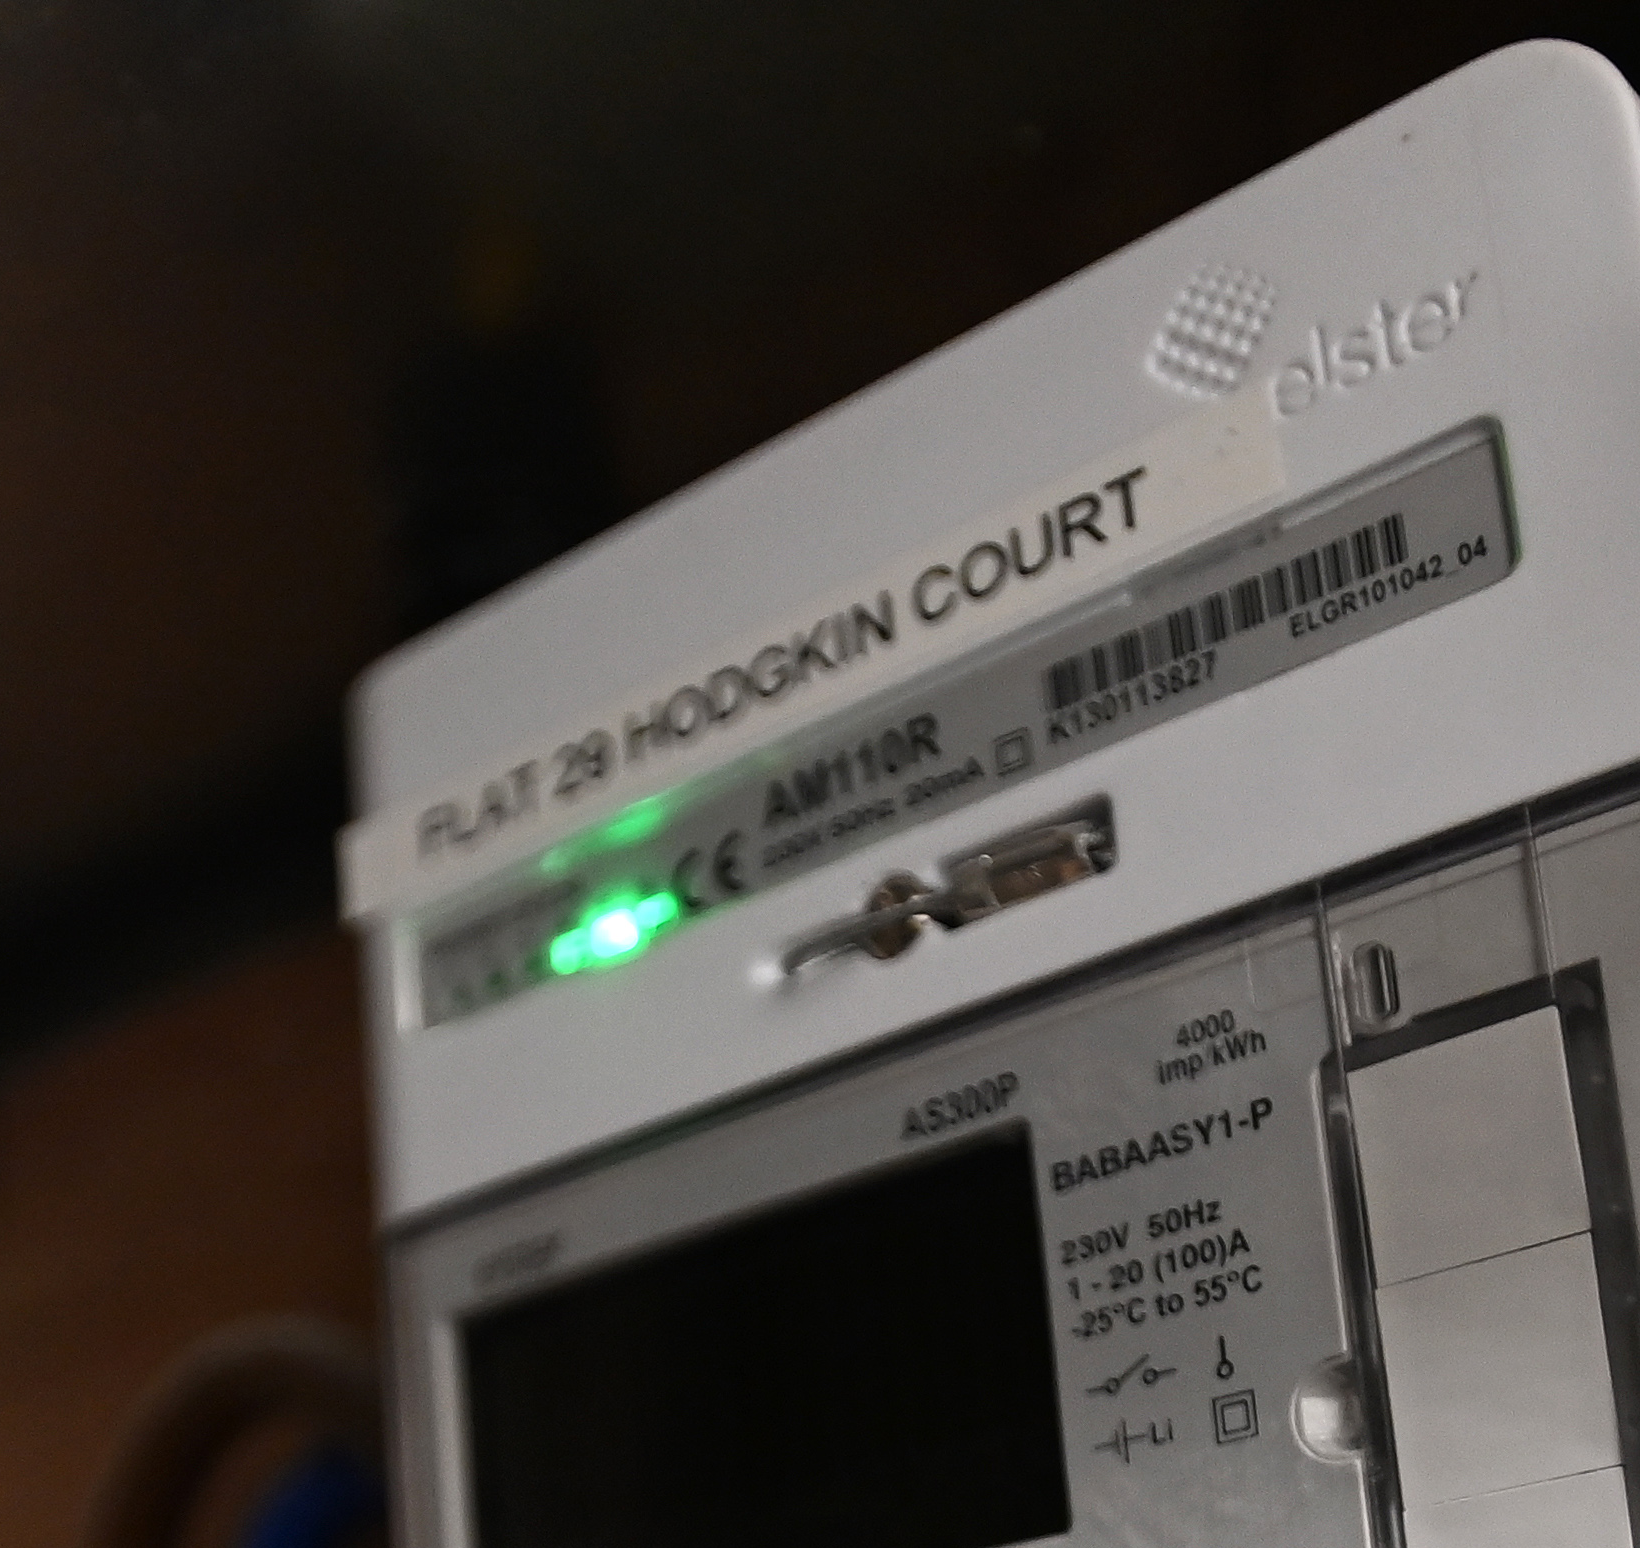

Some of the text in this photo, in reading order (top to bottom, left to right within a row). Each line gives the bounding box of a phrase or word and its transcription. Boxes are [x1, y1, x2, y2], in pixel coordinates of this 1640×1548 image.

[1290, 534, 1488, 638] ELGR101042_04
[416, 465, 1148, 862] FLAT 29 HODGKIN COURT
[1176, 1008, 1236, 1048] 4000
[1051, 1097, 1273, 1192] BABAASY1-P
[1061, 1199, 1222, 1267] 230V 50Hz
[1068, 1276, 1080, 1300] 1
[1110, 1258, 1144, 1291] 20
[1154, 1227, 1251, 1284] (100)A
[1155, 1292, 1185, 1317] to
[1193, 1264, 1263, 1308] 55°C
